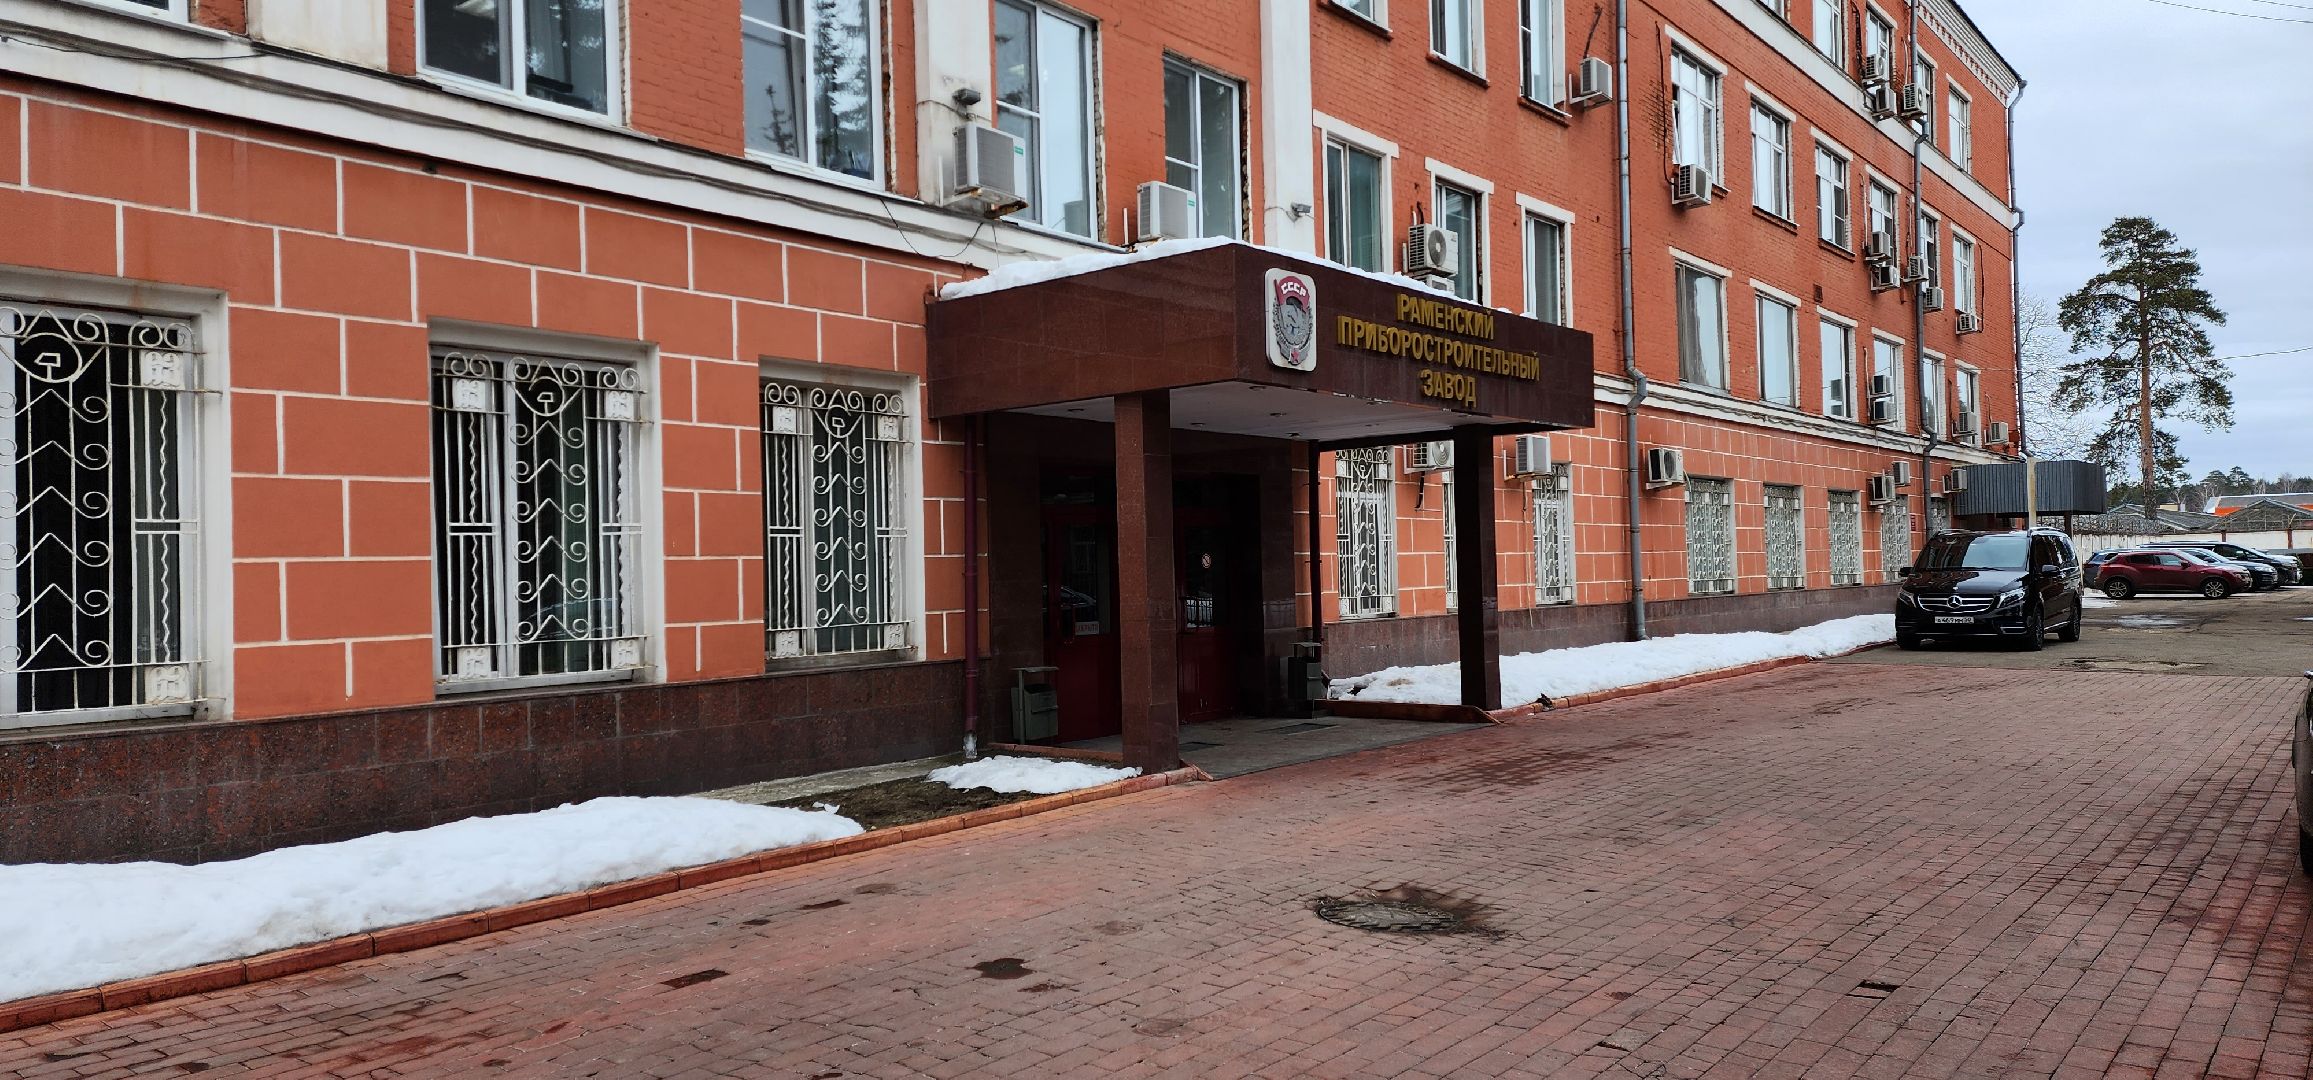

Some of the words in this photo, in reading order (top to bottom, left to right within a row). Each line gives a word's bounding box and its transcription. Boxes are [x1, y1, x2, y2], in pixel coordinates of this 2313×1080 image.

[1281, 281, 1307, 297] СССР
[1398, 293, 1494, 340] РАМЕНСКИЙ
[1337, 315, 1540, 381] ПРИБОРОСТРОИТЕЛЬНЫЙ
[1420, 369, 1477, 408] ЗАВОД
